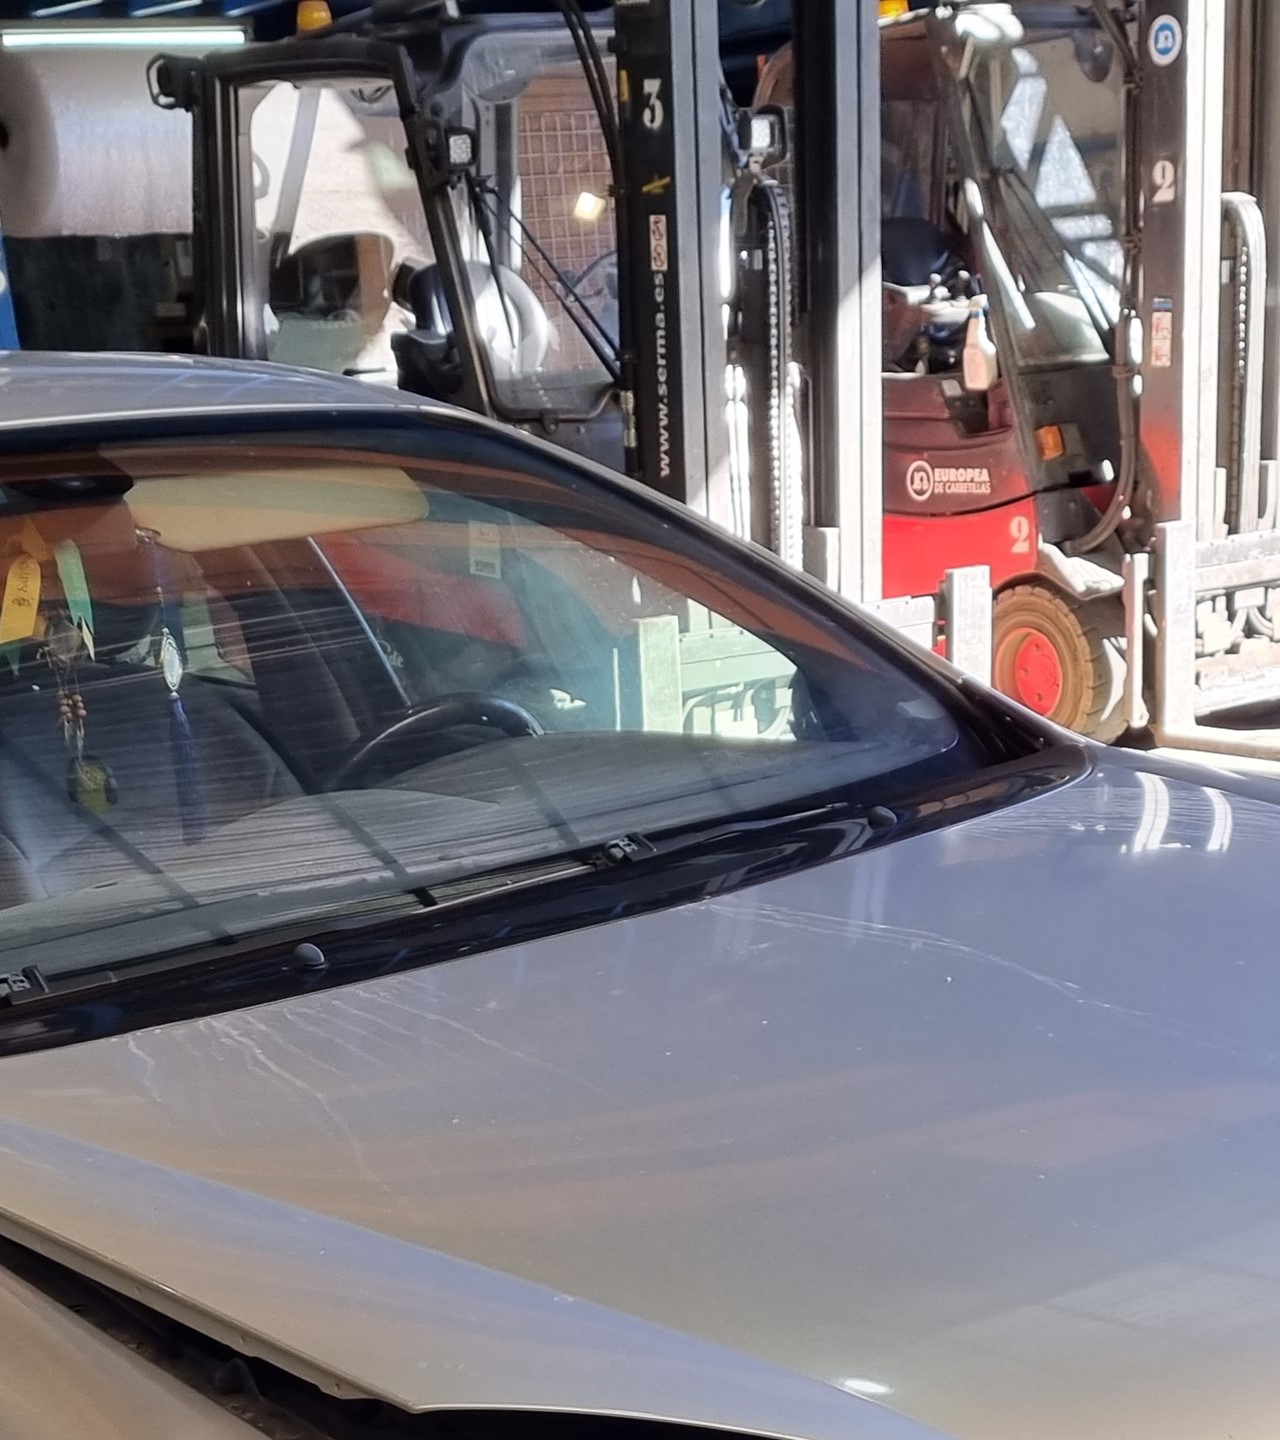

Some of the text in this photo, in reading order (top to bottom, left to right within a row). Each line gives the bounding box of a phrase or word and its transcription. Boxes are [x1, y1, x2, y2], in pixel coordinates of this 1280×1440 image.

[642, 78, 664, 130] 3
[1152, 160, 1176, 202] 2
[654, 272, 671, 477] www.serma.es
[934, 468, 990, 482] EUROPEA
[934, 482, 945, 493] DE
[1009, 515, 1030, 554] 2
